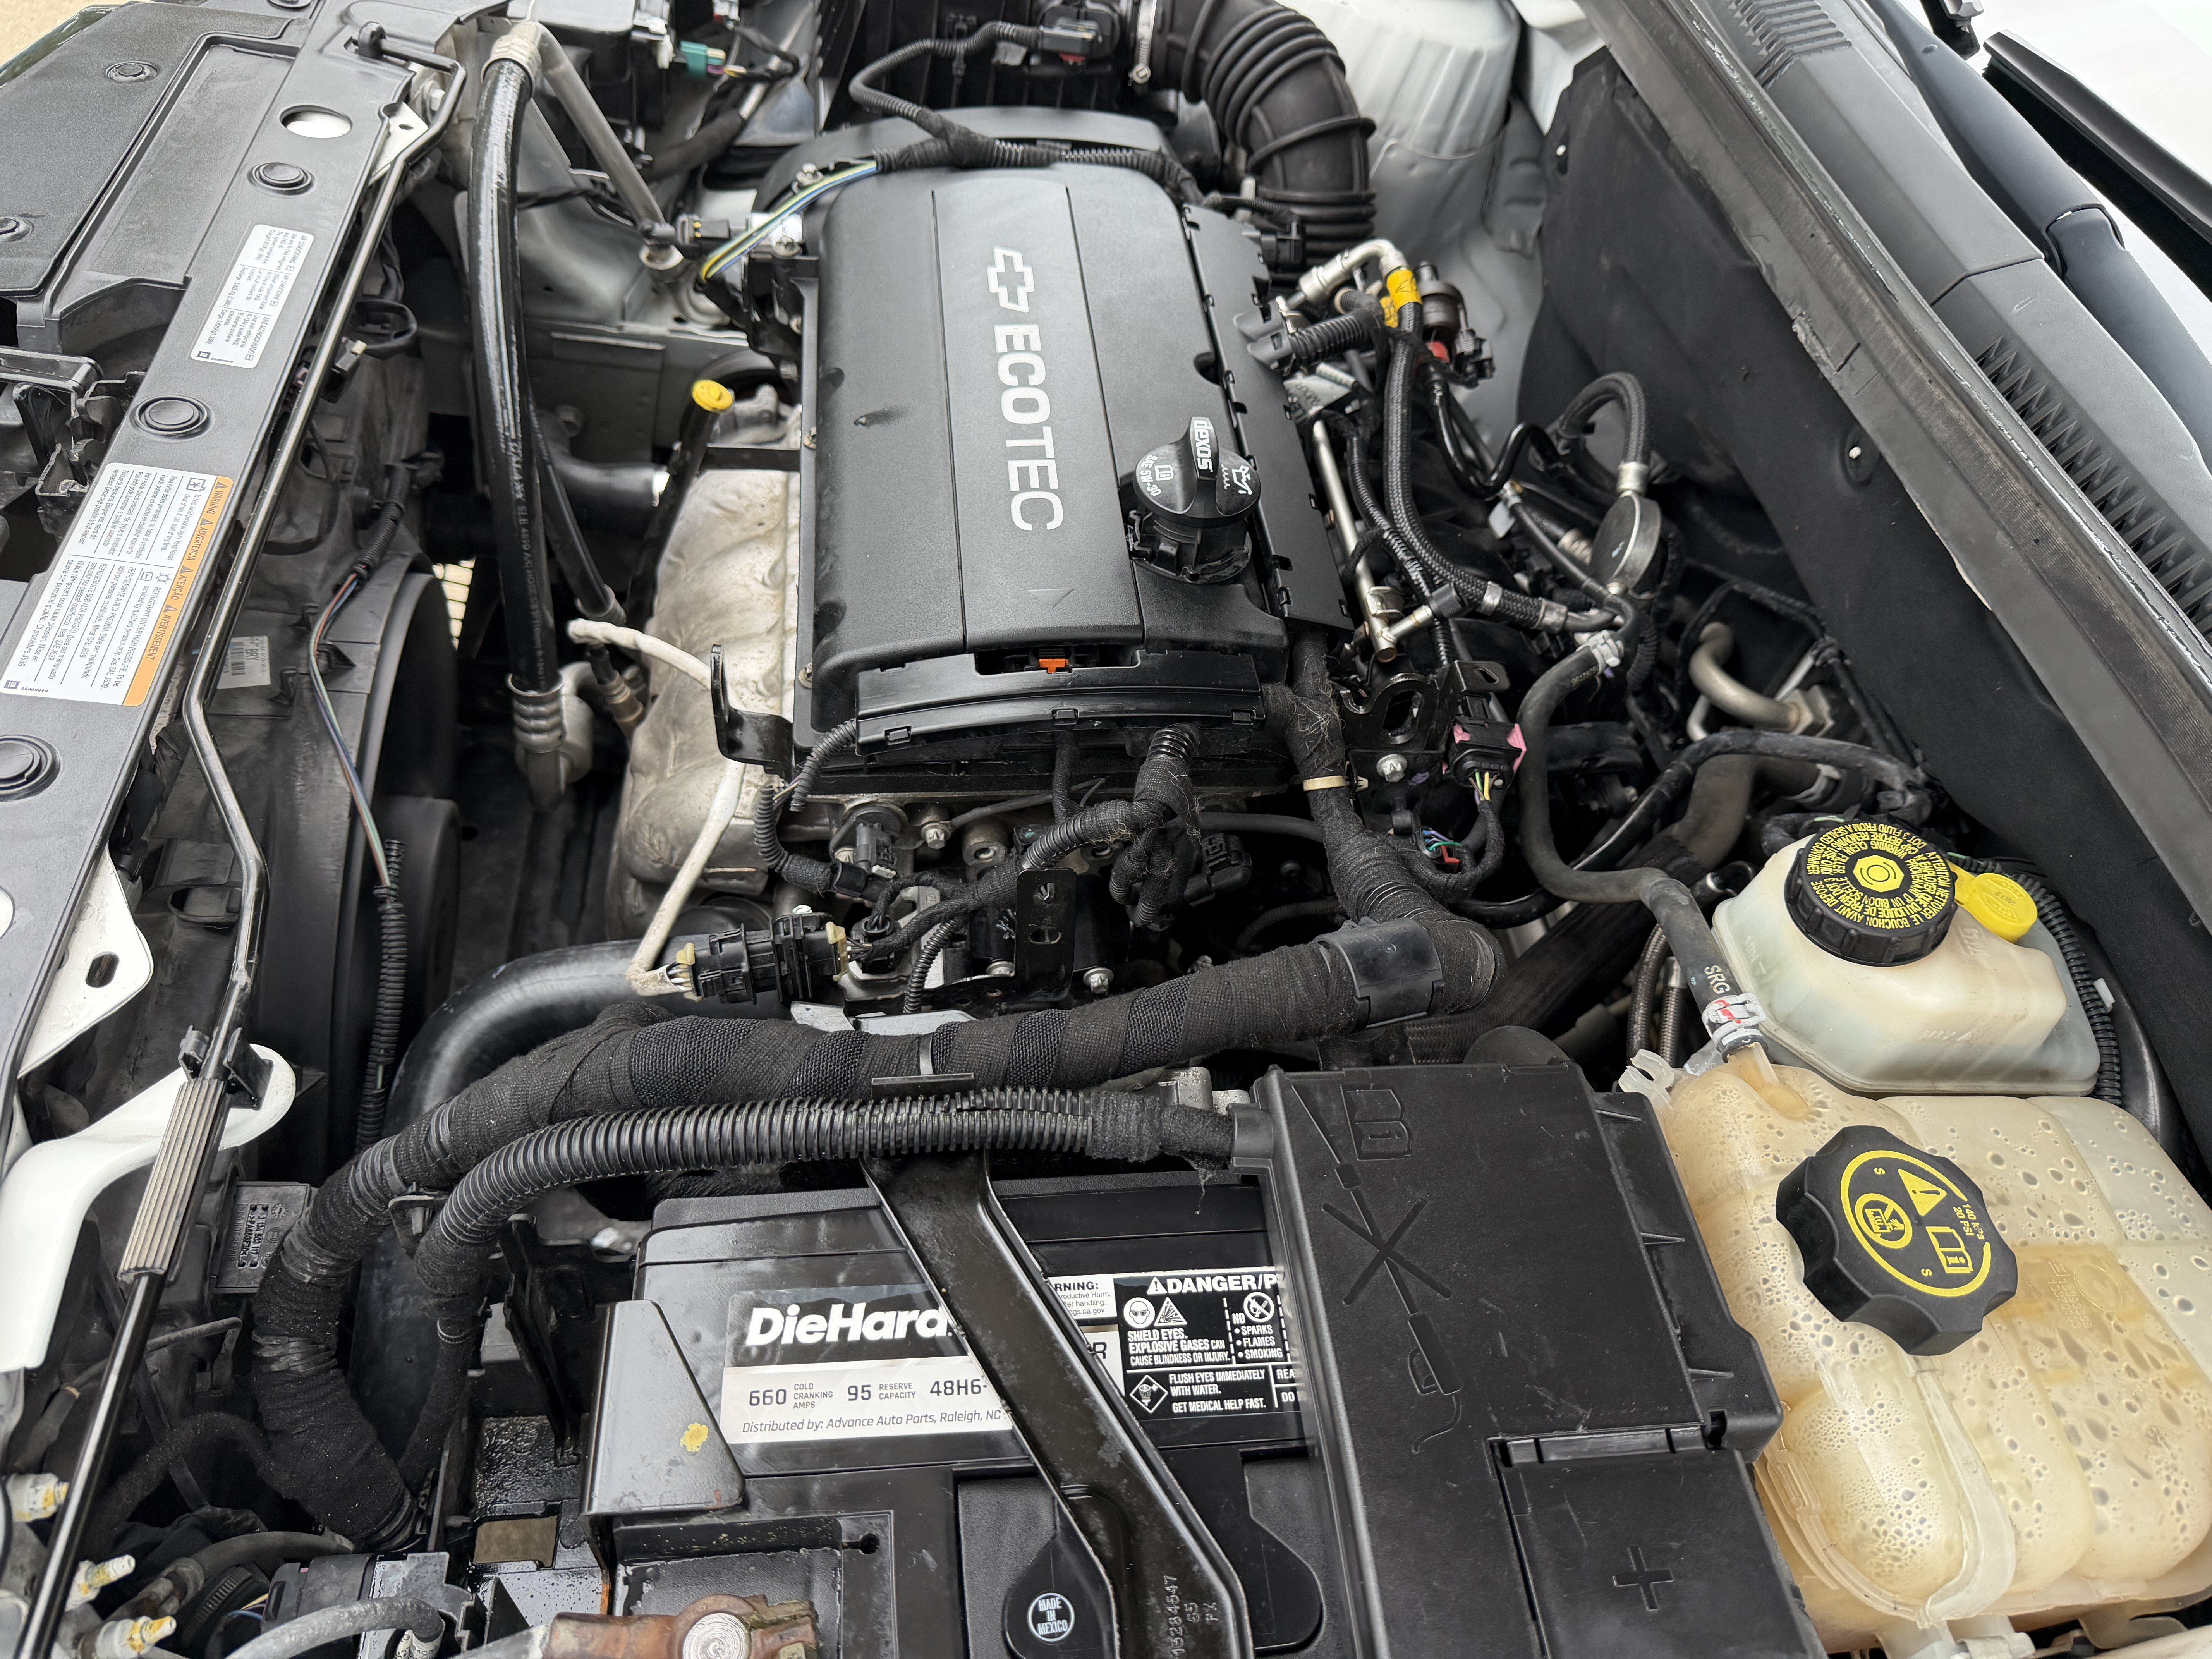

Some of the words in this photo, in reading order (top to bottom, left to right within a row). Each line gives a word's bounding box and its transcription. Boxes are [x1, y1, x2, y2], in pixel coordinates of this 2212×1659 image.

[993, 324, 1064, 531] ECOTEC
[1194, 420, 1213, 470] dexos
[1141, 455, 1158, 468] SAE
[1140, 470, 1162, 496] 5W-30
[206, 490, 224, 514] WARNING
[186, 527, 208, 561] ADVERTENCIA
[62, 559, 74, 574] oeuvre
[72, 560, 85, 573] Fluide
[60, 574, 79, 596] réfrigérant
[117, 567, 136, 597] REFRIGERANTE
[168, 575, 190, 600] ATENÇÃO
[46, 582, 64, 604] personnel
[103, 582, 118, 599] personal
[137, 586, 151, 603] serviced
[56, 597, 66, 608] sous
[110, 602, 121, 612] ALTA
[142, 587, 161, 617] REFRIGERANT
[50, 608, 62, 621] haute
[125, 609, 141, 627] qualified
[38, 622, 55, 643] pression.
[88, 624, 100, 636] Mirar
[135, 618, 148, 634] UNDER
[22, 630, 41, 653] procédure
[84, 637, 94, 646] SAE
[96, 633, 107, 644] Debe
[117, 628, 132, 645] persons
[130, 635, 141, 646] HIGH
[145, 614, 173, 660] AVERTISSEMENT
[34, 644, 46, 655] Mise
[79, 646, 90, 658] J639
[113, 646, 125, 656] only.
[17, 654, 29, 666] J639
[79, 653, 98, 679] manipulado
[110, 657, 120, 665] See
[118, 647, 136, 673] PRESSURE.
[106, 666, 116, 675] SAE
[100, 676, 112, 689] J639.
[1852, 823, 1877, 832] FROM
[1879, 824, 1902, 837] FLUID
[1820, 826, 1848, 844] SEALED
[1831, 832, 1870, 850] REMOVING
[1870, 832, 1903, 846] BEFORE
[1842, 841, 1868, 855] CLEAN
[1901, 844, 1919, 854] CAP
[1907, 836, 1927, 849] DOT
[1822, 847, 1839, 860] USE
[1870, 841, 1907, 859] WARNING
[1807, 842, 1826, 874] CONTAINER
[1832, 853, 1850, 874] FILLER
[1820, 860, 1834, 875] ONLY
[1925, 852, 1951, 887] ATTENTION
[1905, 859, 1924, 897] PROVENANT
[1919, 861, 1937, 894] EMPLOYER
[1810, 880, 1839, 907] DEPOSE
[1826, 883, 1844, 896] DOT
[1836, 876, 1863, 900] SCELLE
[1838, 893, 1864, 912] FREIN
[1862, 895, 1890, 908] BIDON
[1891, 897, 1905, 907] UN
[1915, 893, 1933, 907] QUE
[1920, 888, 1949, 919] NETTOYER
[1834, 905, 1865, 922] AVANT
[1863, 905, 1876, 916] DE
[1878, 906, 1910, 918] LIQUIDE
[1906, 902, 1922, 914] DU
[1866, 916, 1910, 929] BOUCHON
[1910, 914, 1924, 925] LE
[1704, 965, 1731, 994] SRG
[1953, 1207, 1965, 1219] 20
[1963, 1204, 1977, 1220] 140
[1054, 1281, 1098, 1291] RNING:
[1166, 1274, 1279, 1294] DANGER/P
[1232, 1313, 1245, 1324] NO
[1127, 1330, 1159, 1341] SHIELD
[1161, 1328, 1188, 1340] EYES.
[1241, 1324, 1273, 1336] SPARKS
[1129, 1340, 1178, 1354] EXPLOSIVE
[1180, 1339, 1209, 1351] GASES
[1211, 1339, 1225, 1349] CAN
[1243, 1336, 1276, 1347] FLAMES
[1130, 1355, 1153, 1366] CAUSE
[1154, 1353, 1192, 1364] BLINDNESS
[1193, 1352, 1204, 1363] OR
[1204, 1351, 1231, 1362] INJURY.
[1244, 1348, 1283, 1360] SMOKING
[1169, 1372, 1194, 1384] FLUSH
[1195, 1372, 1214, 1382] EYES
[1216, 1369, 1265, 1381] IMMEDIATELY
[1276, 1369, 1295, 1379] REA
[847, 1385, 871, 1401] 95
[879, 1382, 913, 1390] RESERVE
[1170, 1385, 1190, 1397] WITH
[1191, 1384, 1222, 1395] WATER.
[749, 1388, 787, 1406] 660
[793, 1391, 833, 1400] CRANKING
[878, 1391, 916, 1400] CAPACITY
[1281, 1391, 1295, 1402] DO
[793, 1401, 816, 1409] AMPS
[1172, 1401, 1188, 1413] GET
[1188, 1400, 1224, 1412] MEDICAL
[1224, 1399, 1243, 1410] HELP
[1245, 1398, 1266, 1409] FAST.
[742, 1418, 804, 1433] Distributed
[807, 1419, 824, 1432] by:
[826, 1417, 874, 1429] Advance
[876, 1415, 903, 1426] Auto
[905, 1413, 937, 1426] Parts,
[939, 1410, 982, 1423] Raleigh,
[986, 1410, 1001, 1420] NC
[1038, 1597, 1062, 1611] MADE
[1046, 1610, 1056, 1621] IN
[1037, 1619, 1068, 1635] MEXICO
